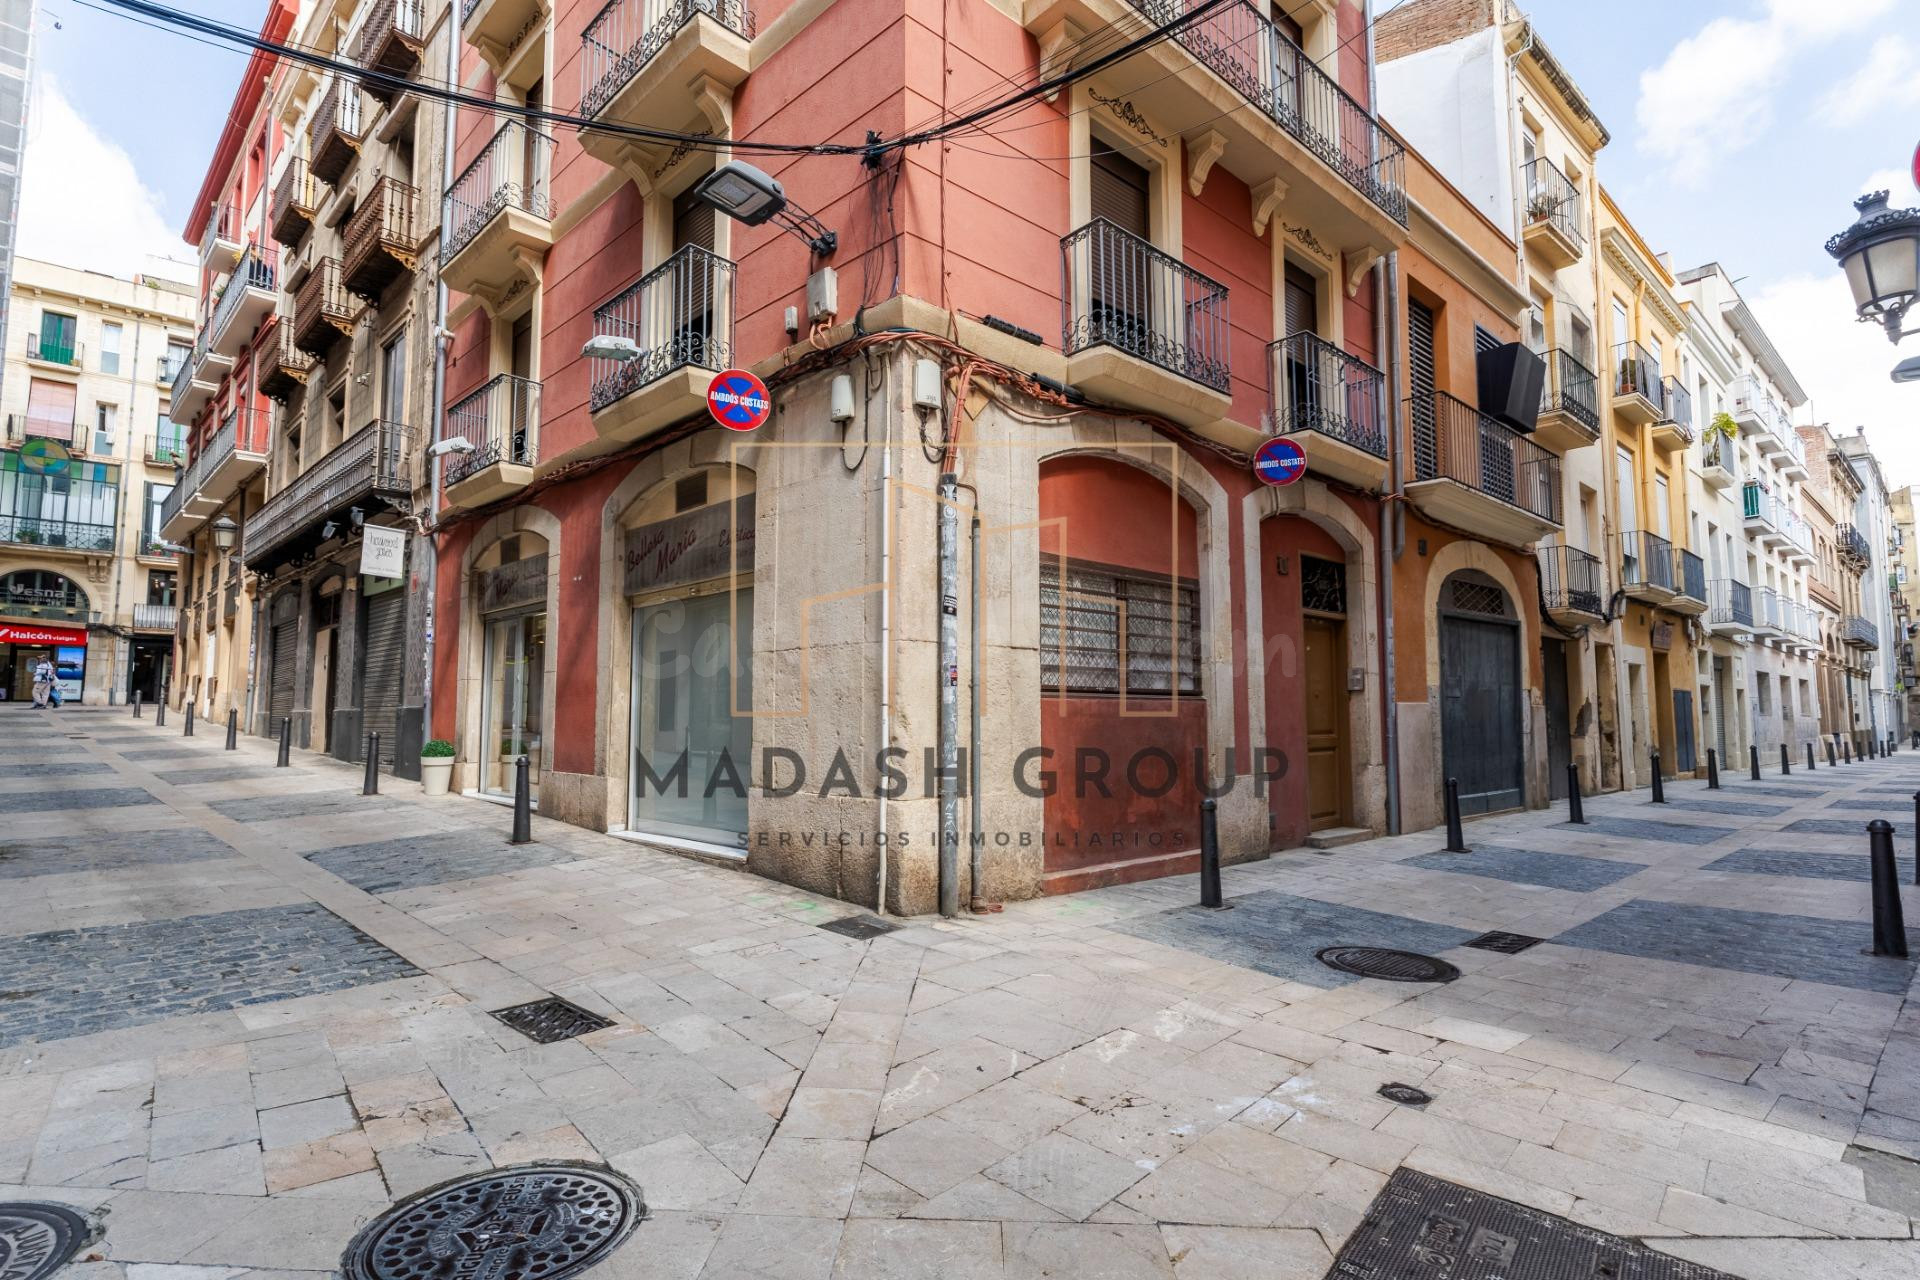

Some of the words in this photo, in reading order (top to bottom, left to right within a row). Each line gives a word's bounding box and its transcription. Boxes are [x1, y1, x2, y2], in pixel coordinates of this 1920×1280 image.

[740, 396, 769, 410] COSTATS
[1280, 457, 1305, 467] COSTATS
[10, 630, 52, 640] Halcón
